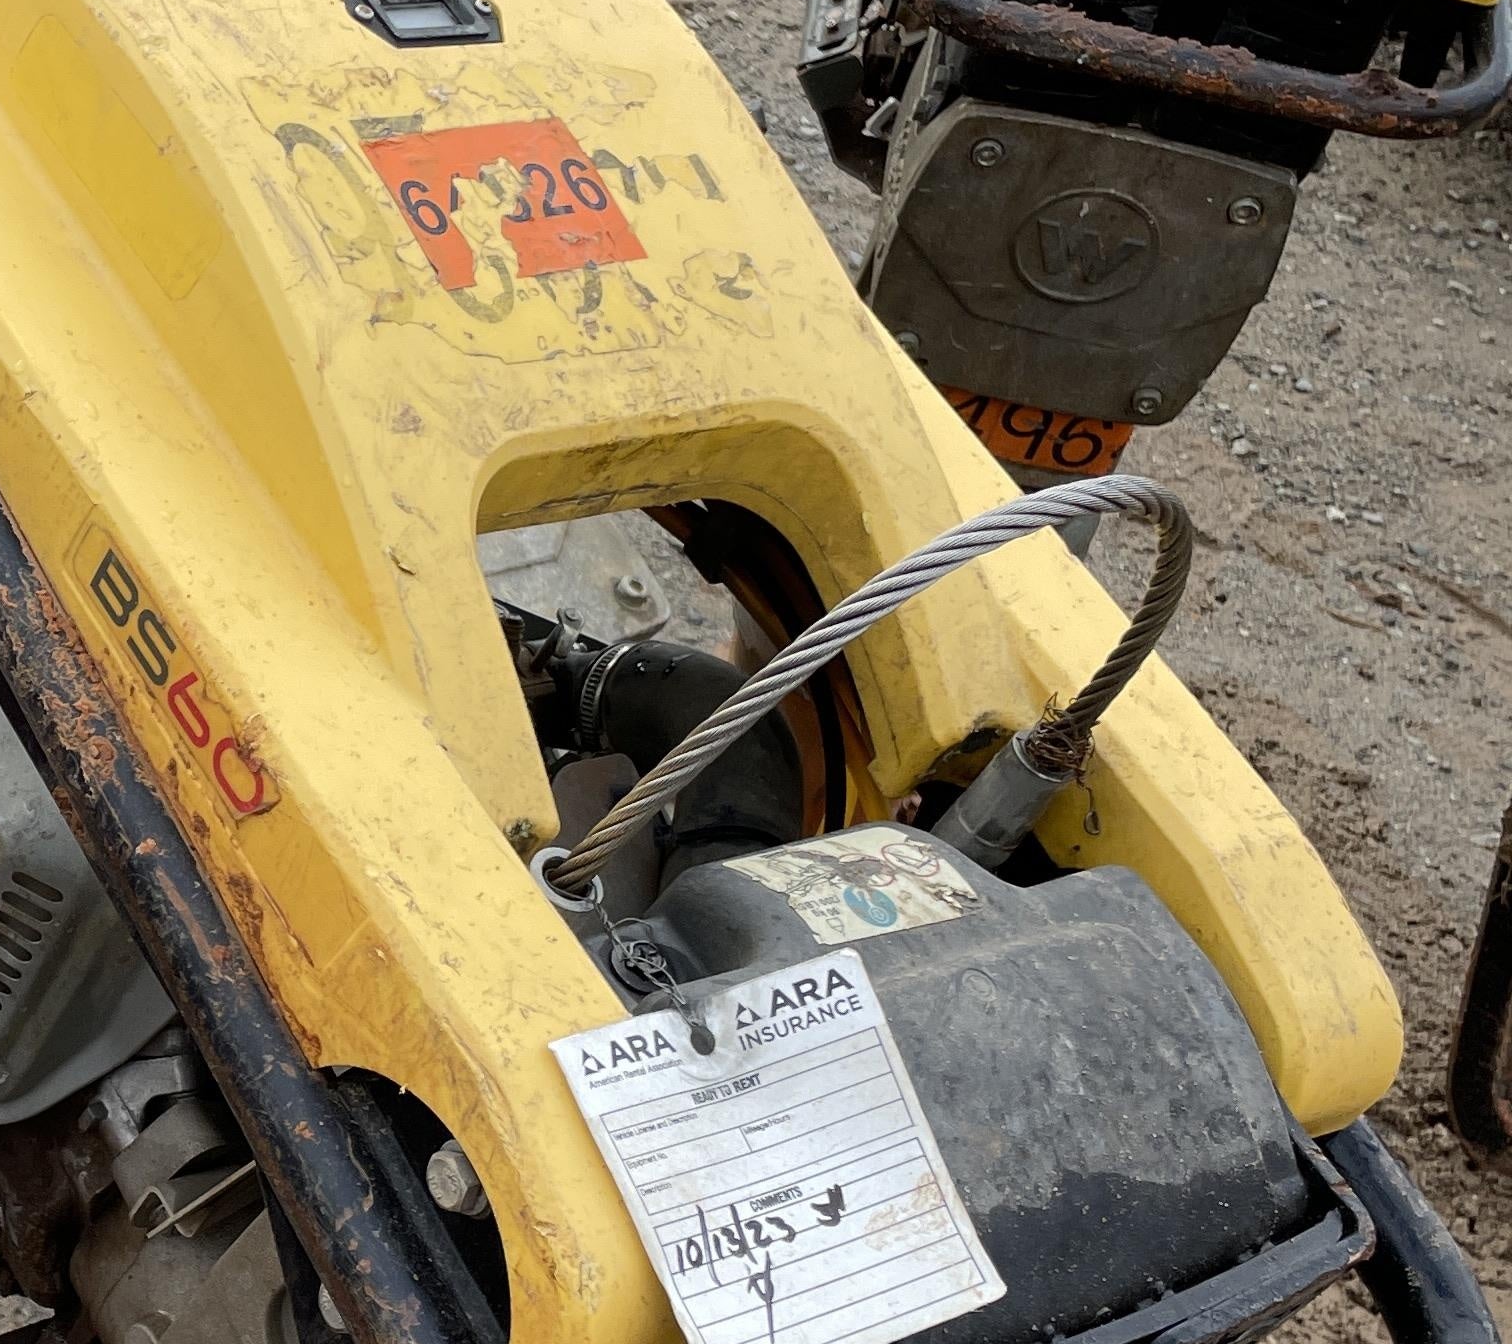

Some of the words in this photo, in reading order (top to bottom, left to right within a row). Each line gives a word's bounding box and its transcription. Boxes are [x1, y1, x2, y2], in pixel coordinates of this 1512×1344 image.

[89, 547, 265, 813] BS60
[770, 968, 855, 1018] ARA
[738, 994, 864, 1052] INSURANCE
[610, 1029, 677, 1069] ARA
[588, 1072, 623, 1091] American
[623, 1065, 647, 1081] Rental
[646, 1057, 685, 1076] Association
[691, 1086, 719, 1106] READY
[719, 1084, 732, 1099] TO
[734, 1073, 762, 1095] RENT
[748, 1186, 804, 1213] COMMENTS
